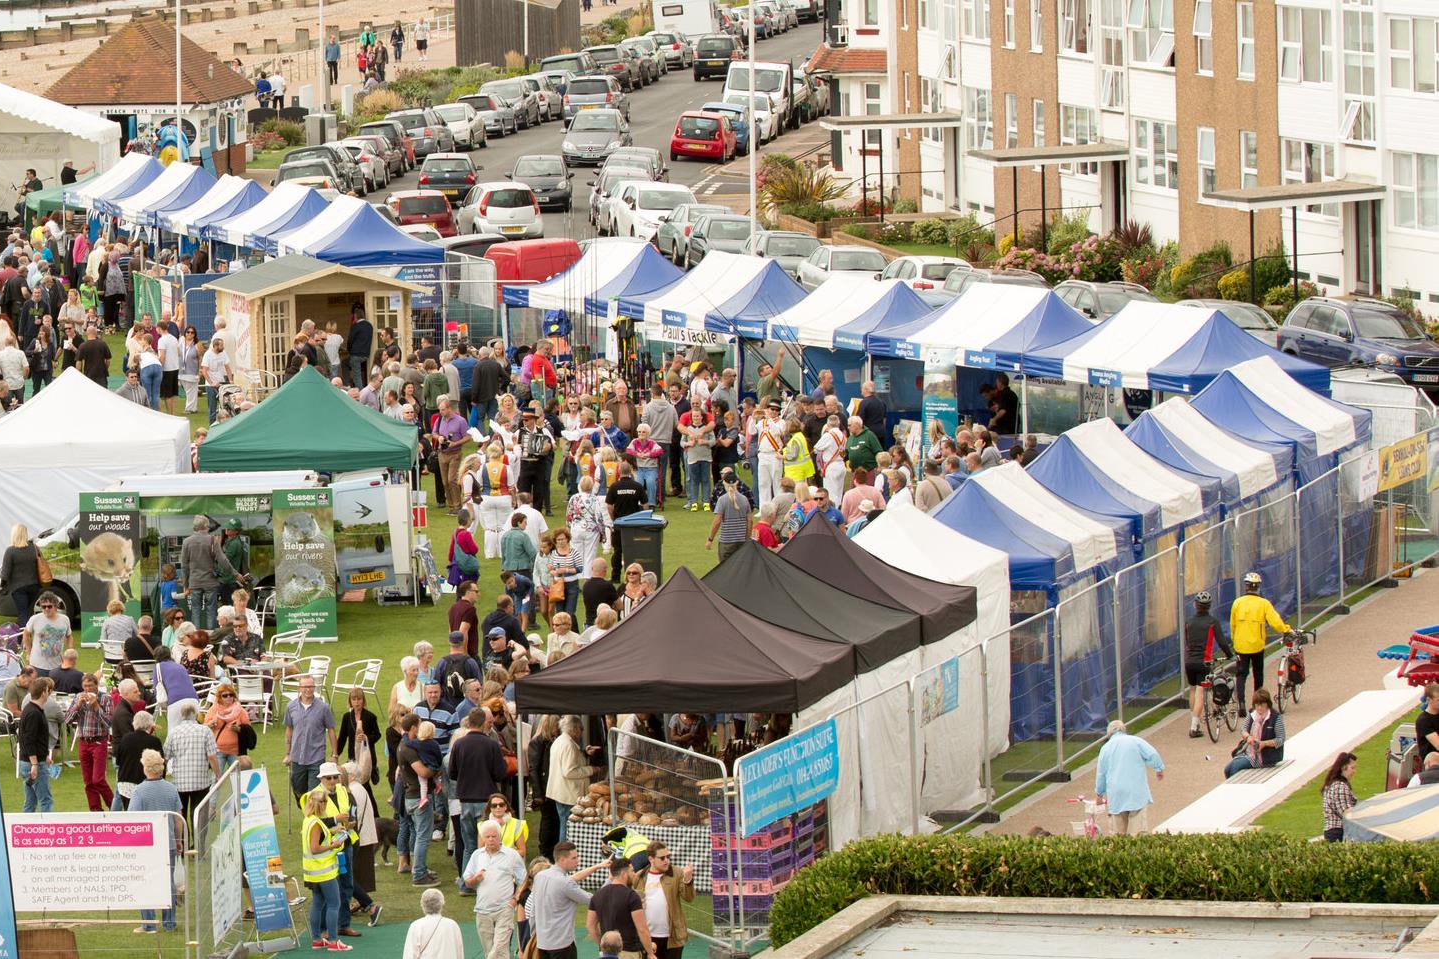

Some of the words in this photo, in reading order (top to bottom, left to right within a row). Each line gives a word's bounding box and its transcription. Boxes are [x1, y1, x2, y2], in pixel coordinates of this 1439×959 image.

[662, 326, 686, 341] Paul's
[687, 329, 717, 344] Tackle
[1084, 391, 1115, 404] ANGLIG
[94, 496, 122, 504] Sussex
[287, 493, 316, 501] Sussex
[88, 513, 109, 524] Help
[111, 514, 130, 523] save
[88, 523, 103, 531] our
[104, 521, 131, 531] woods
[283, 541, 303, 552] Help
[305, 542, 325, 550] save
[285, 552, 300, 560] our
[301, 551, 323, 560] rivers
[352, 573, 368, 583] HY13
[369, 572, 383, 581] LHE
[13, 825, 56, 835] Choosing
[57, 826, 65, 834] a
[67, 825, 91, 836] good
[92, 824, 122, 835] Letting
[123, 824, 151, 835] agent
[13, 837, 20, 845] is
[33, 838, 55, 847] easy
[78, 836, 84, 845] 2
[87, 836, 94, 845] 3
[30, 852, 42, 861] No
[44, 852, 57, 861] set
[58, 853, 69, 862] up
[71, 852, 86, 860] fee
[88, 852, 97, 860] or
[122, 851, 137, 860] fee
[21, 865, 28, 873] 2.
[30, 865, 49, 873] Free
[51, 865, 69, 873] rent
[78, 864, 100, 875] legal
[102, 863, 146, 875] protection
[31, 876, 43, 884] on
[45, 874, 55, 883] all
[57, 874, 100, 885] managed
[22, 886, 28, 894] 3.
[31, 885, 71, 894] Members
[73, 885, 82, 893] of
[31, 896, 51, 904] SAFE
[53, 895, 80, 905] Agent
[82, 895, 99, 903] and
[101, 895, 116, 903] the
